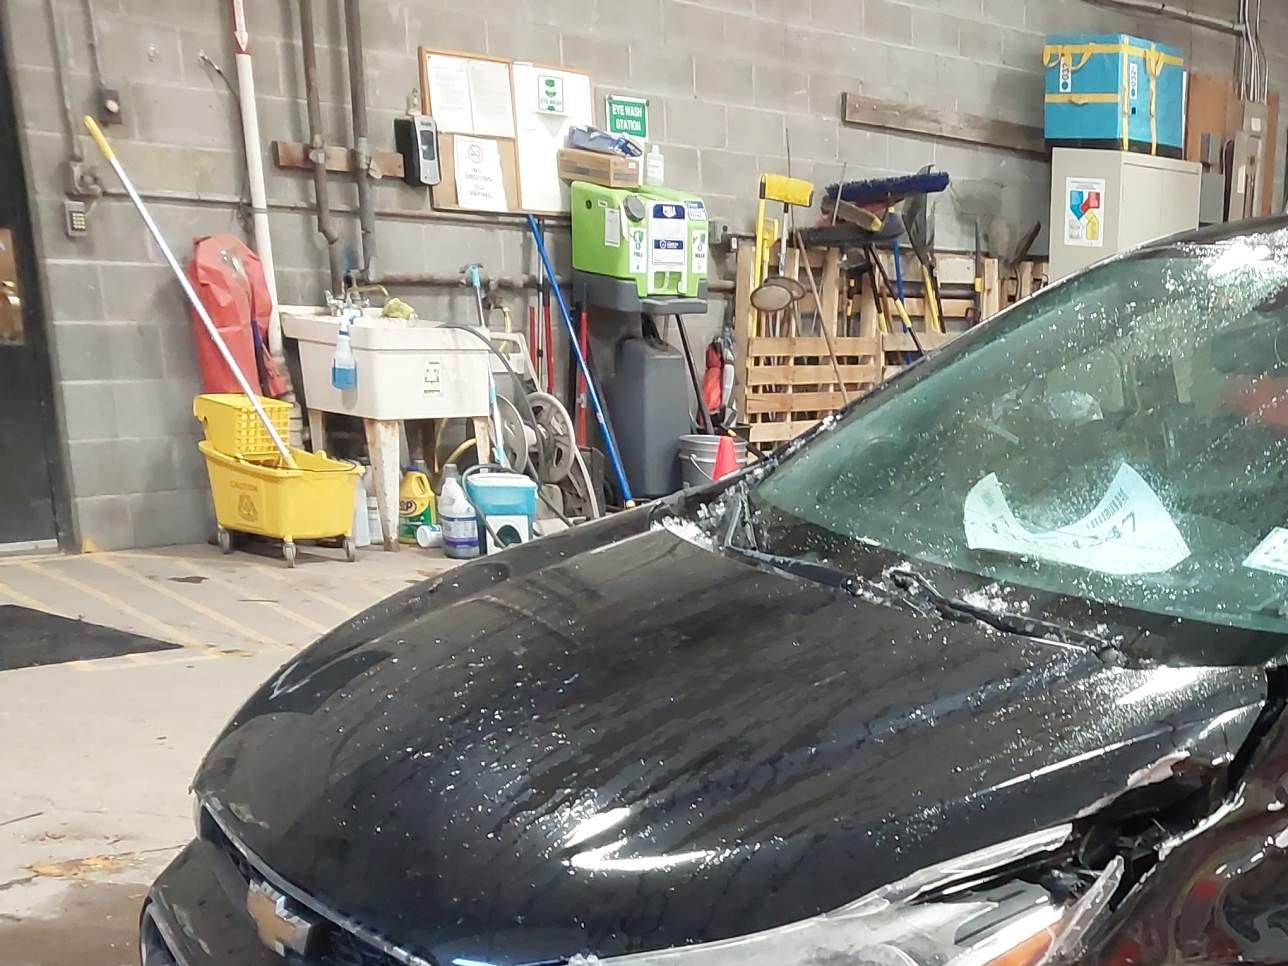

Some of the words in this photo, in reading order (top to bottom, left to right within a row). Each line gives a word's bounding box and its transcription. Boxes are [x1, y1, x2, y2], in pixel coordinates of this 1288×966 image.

[611, 103, 625, 116] EYE
[624, 105, 643, 117] WASH
[615, 118, 642, 131] STATION
